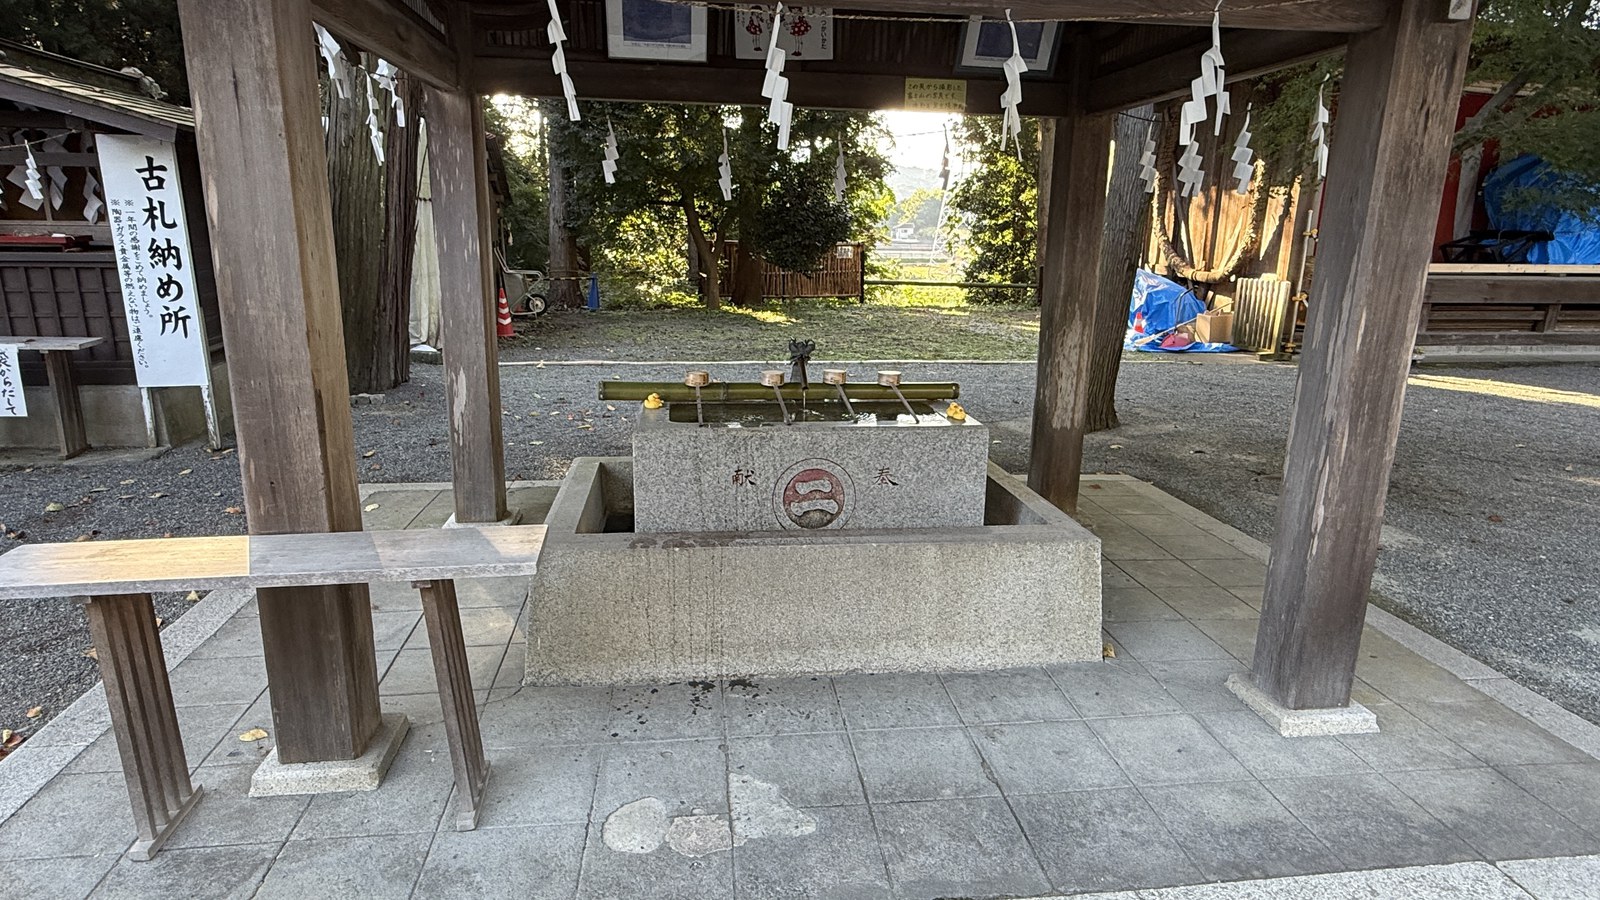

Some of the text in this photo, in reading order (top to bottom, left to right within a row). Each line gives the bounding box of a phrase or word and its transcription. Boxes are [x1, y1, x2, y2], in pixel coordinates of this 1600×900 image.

[135, 155, 191, 339] 古札納め所
